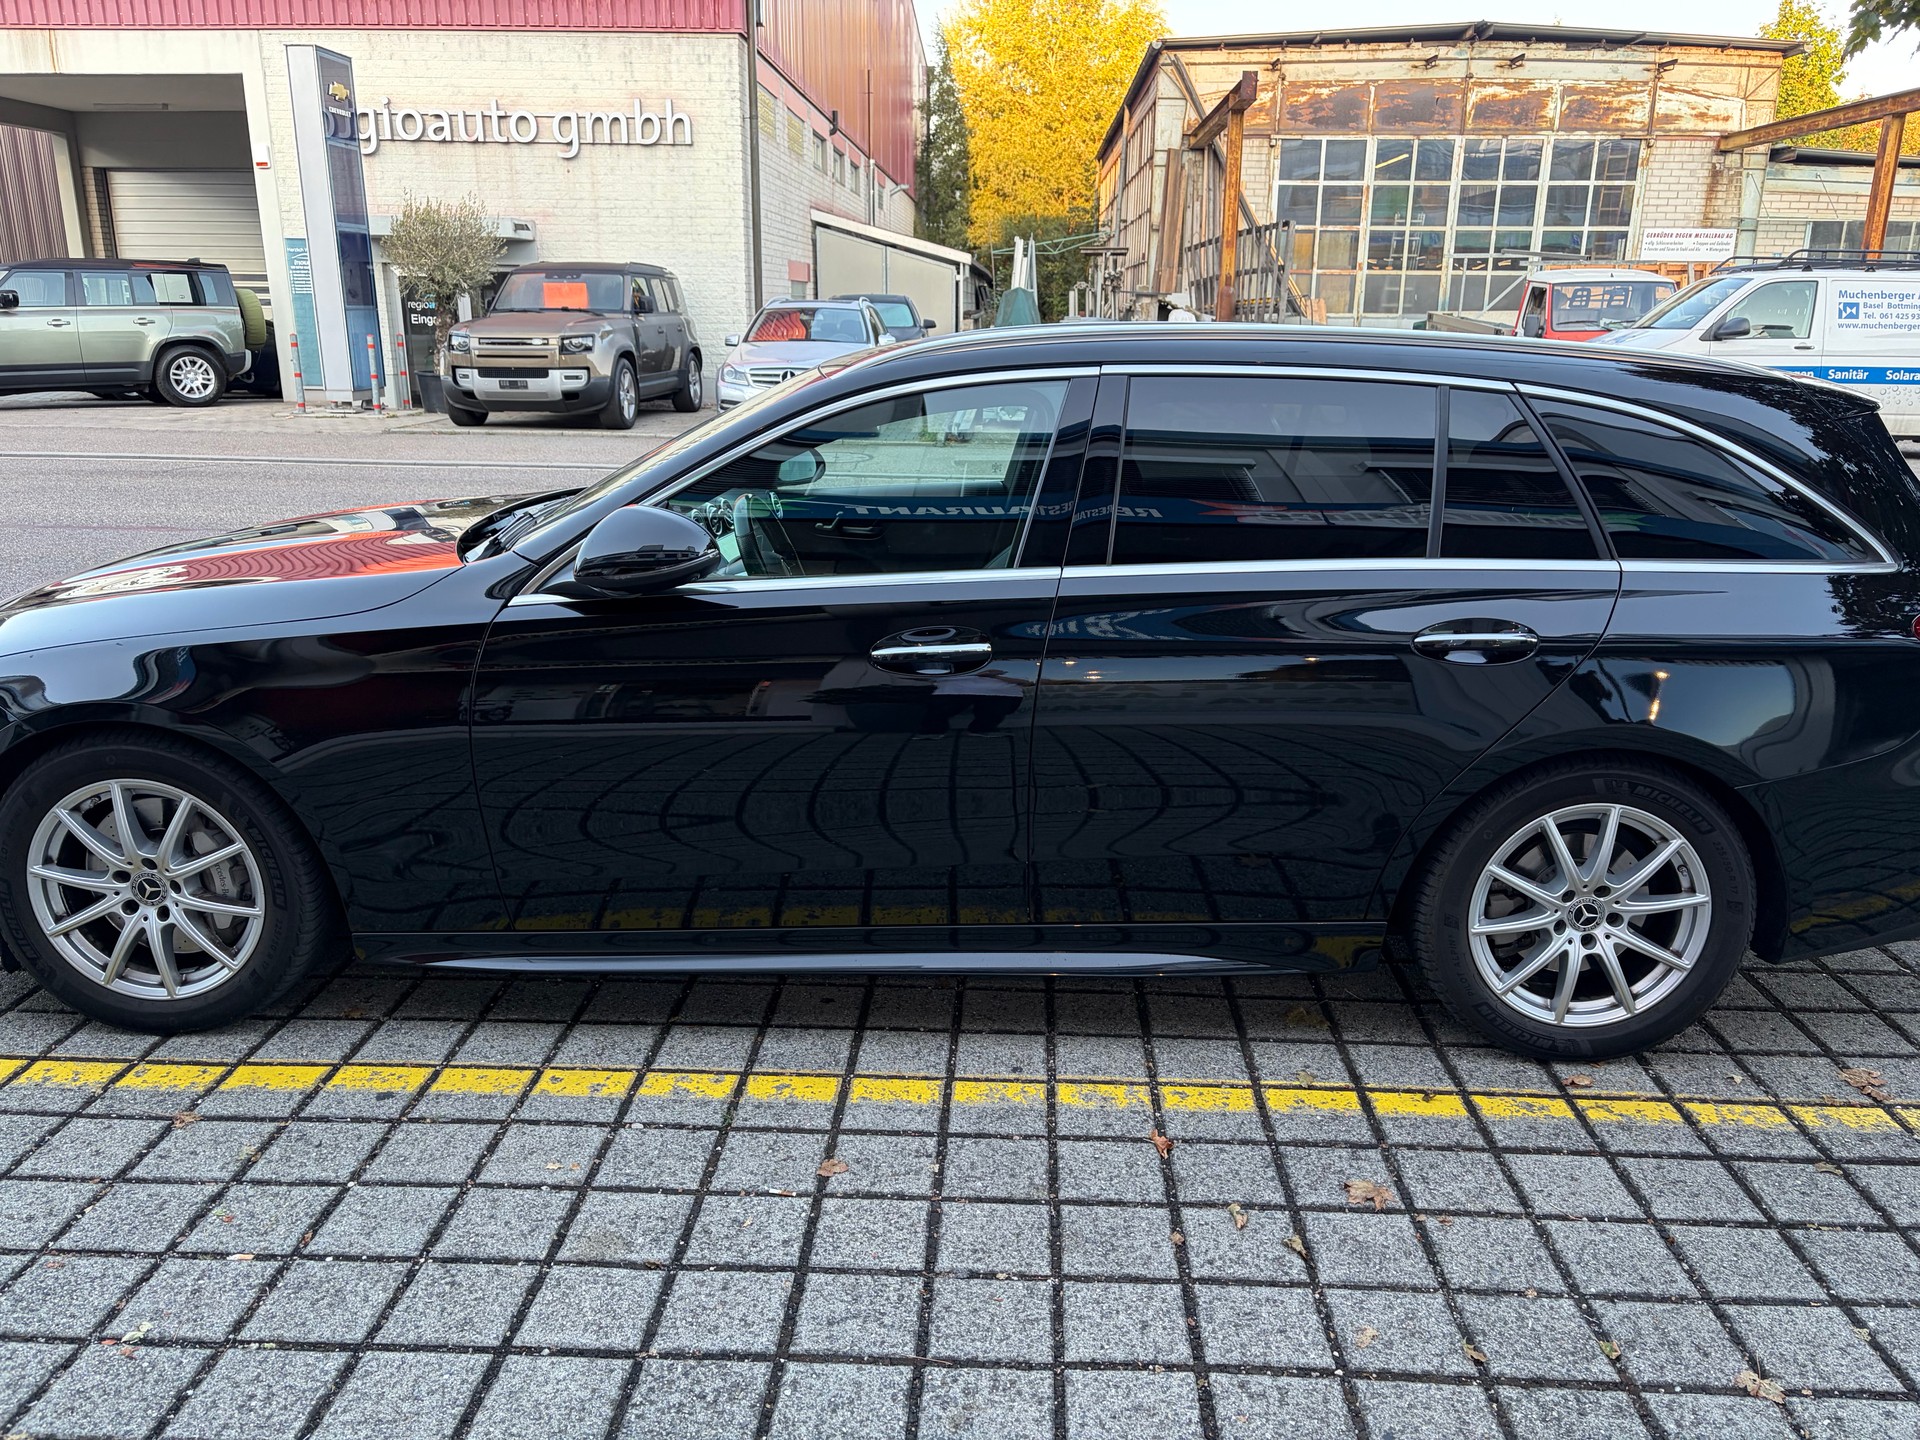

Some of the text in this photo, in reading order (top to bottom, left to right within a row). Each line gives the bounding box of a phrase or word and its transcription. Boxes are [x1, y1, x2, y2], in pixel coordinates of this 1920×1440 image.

[357, 96, 693, 158] gioauto gmbh
[1838, 290, 1916, 302] Muchenberger
[1887, 302, 1920, 311] Bottmin
[1879, 312, 1893, 320] 061
[1895, 312, 1909, 320] 425
[1828, 369, 1869, 380] Sanitär
[1632, 783, 1716, 834] MICHELIN
